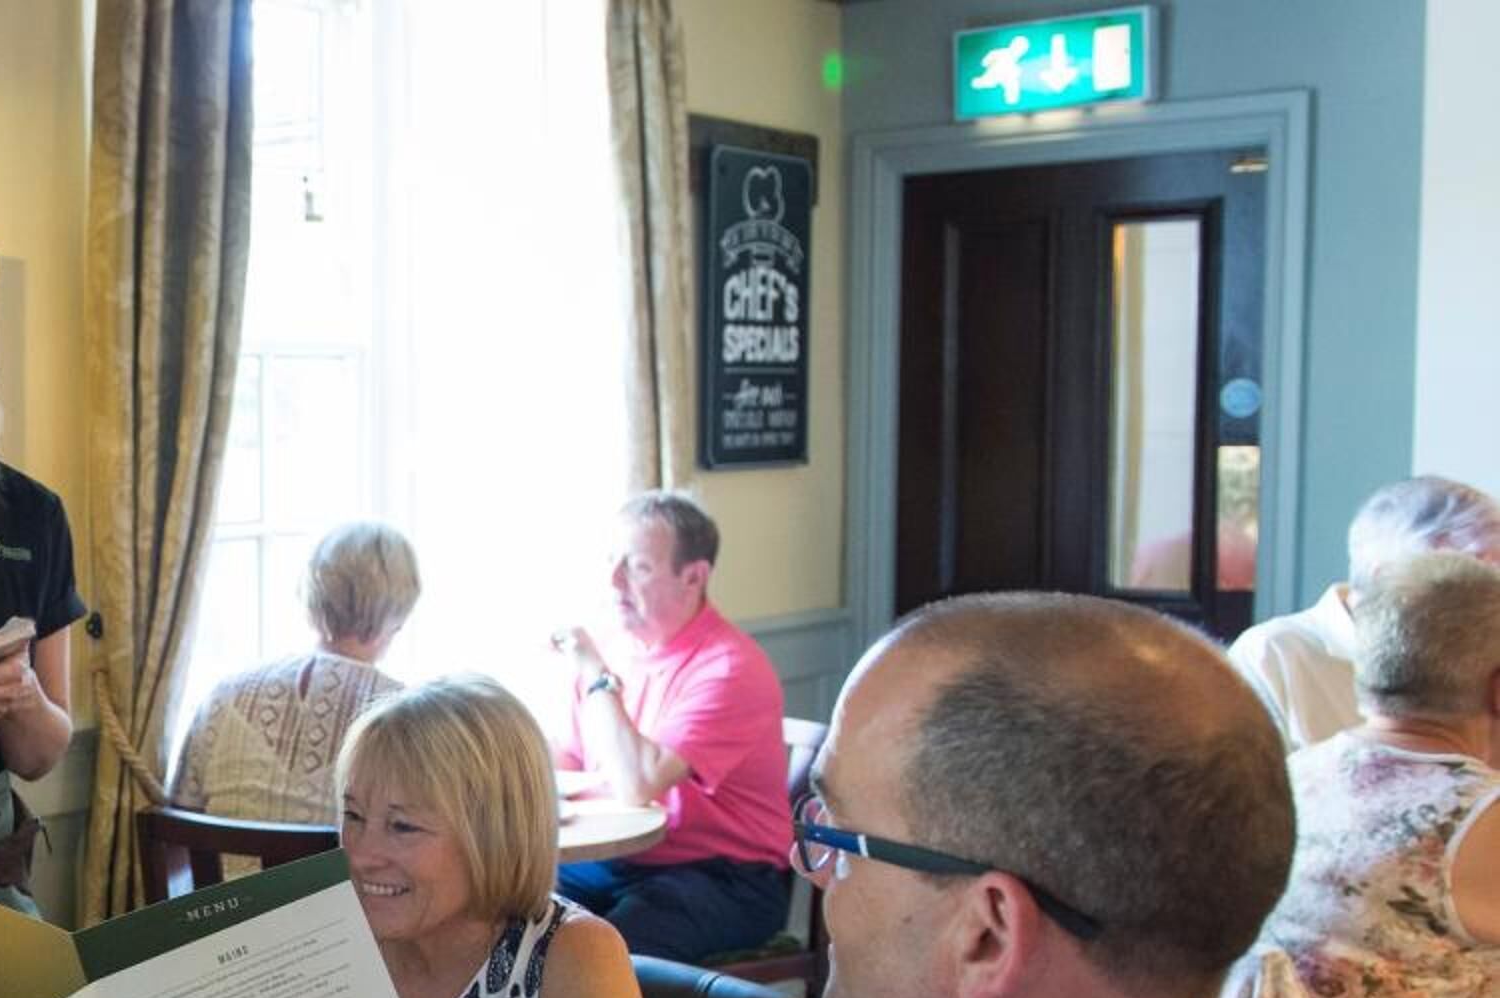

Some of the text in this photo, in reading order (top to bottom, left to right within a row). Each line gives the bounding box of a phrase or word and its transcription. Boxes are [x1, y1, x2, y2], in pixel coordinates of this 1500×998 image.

[724, 267, 800, 323] CHEF'S
[723, 324, 800, 363] SPECIALS
[186, 897, 240, 922] MENU
